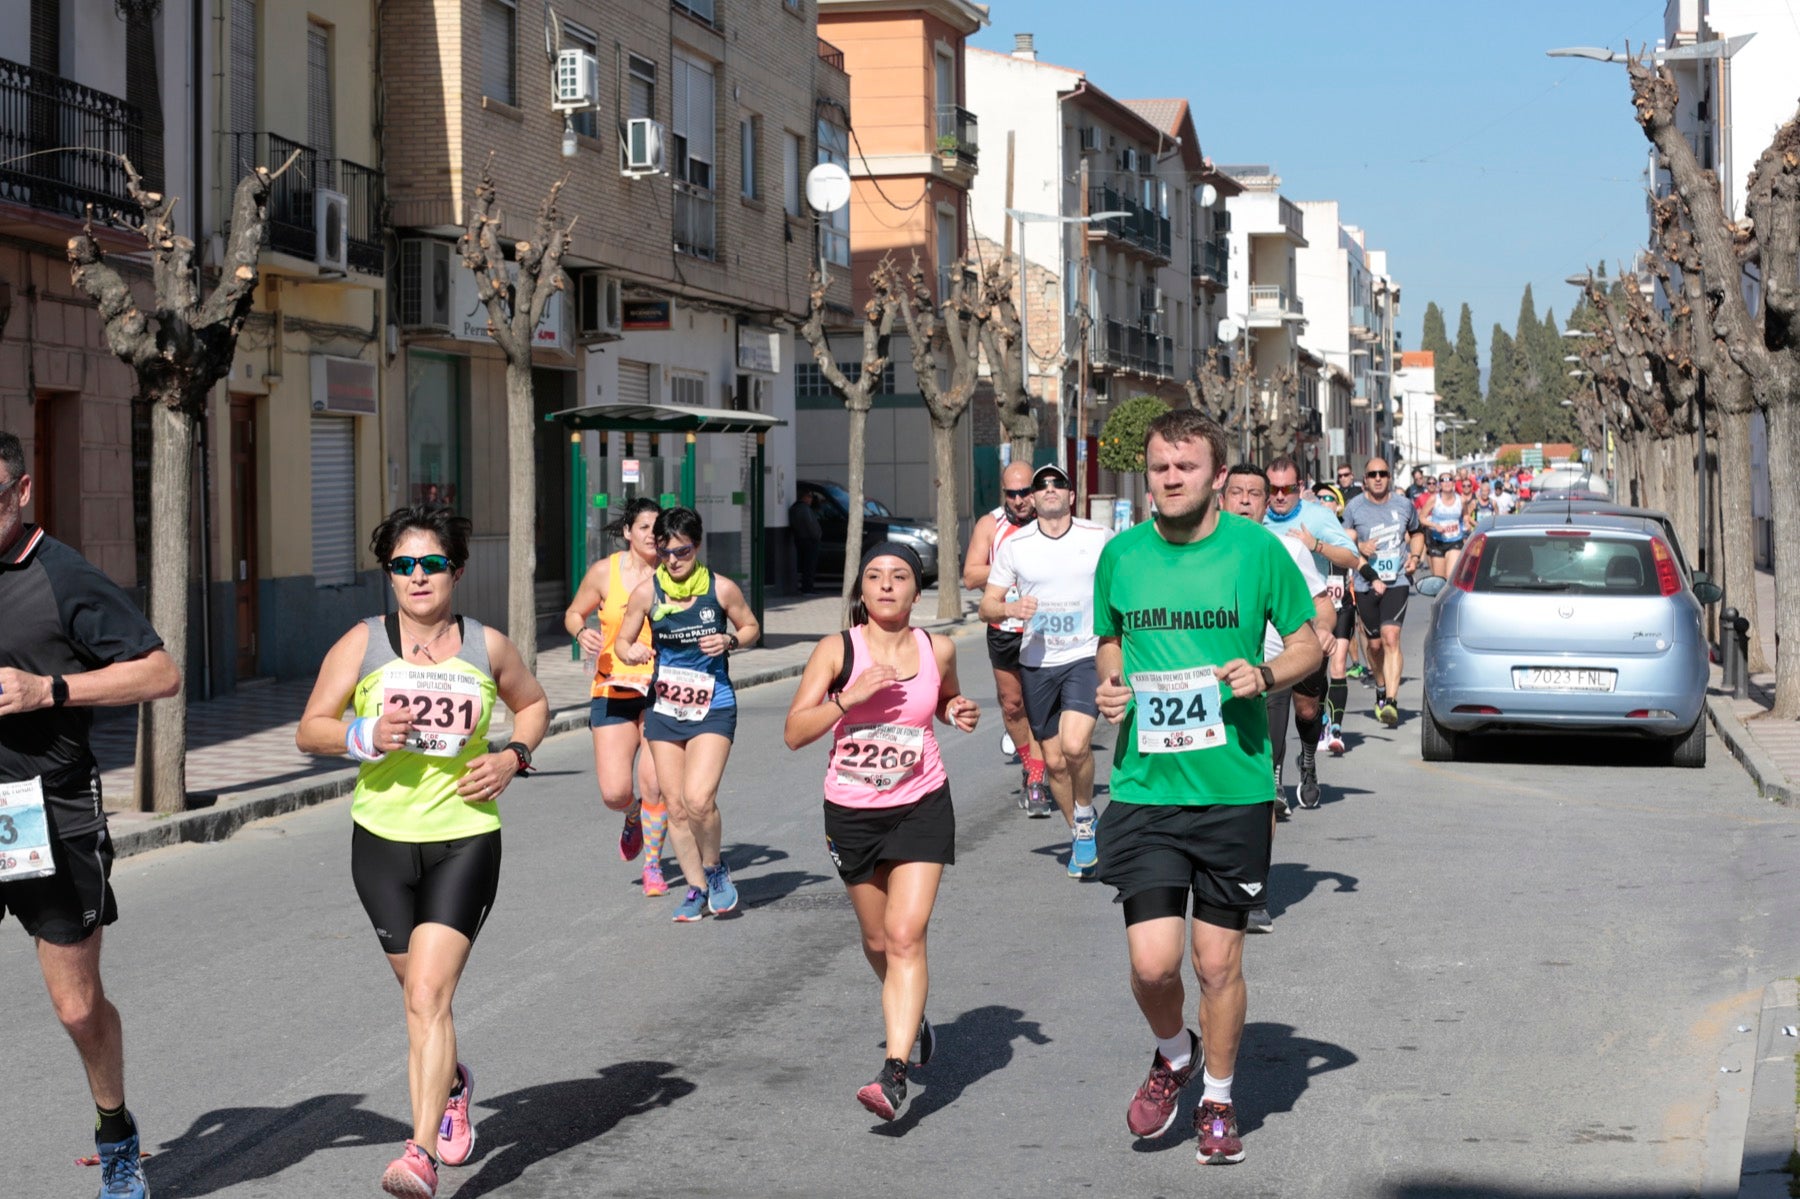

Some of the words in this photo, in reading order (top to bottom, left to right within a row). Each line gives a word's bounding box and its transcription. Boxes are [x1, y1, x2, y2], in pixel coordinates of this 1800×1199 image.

[1378, 560, 1393, 571] 50
[1125, 607, 1167, 630] TEAM
[1170, 595, 1240, 630] HALCÓN
[1038, 615, 1075, 633] 298
[658, 632, 685, 640] PAZITO
[690, 626, 717, 638] PAZITO
[408, 670, 425, 680] GRAN
[426, 671, 448, 682] PREMIO
[448, 672, 456, 682] DE
[457, 673, 475, 685] FONDO
[1192, 667, 1211, 679] FONDO
[1533, 669, 1571, 684] 7023
[1577, 670, 1606, 686] FNL
[416, 681, 452, 691] DIPUTACIÓN
[657, 682, 709, 706] 2238
[1149, 693, 1207, 726] 324
[0, 814, 18, 845] 3
